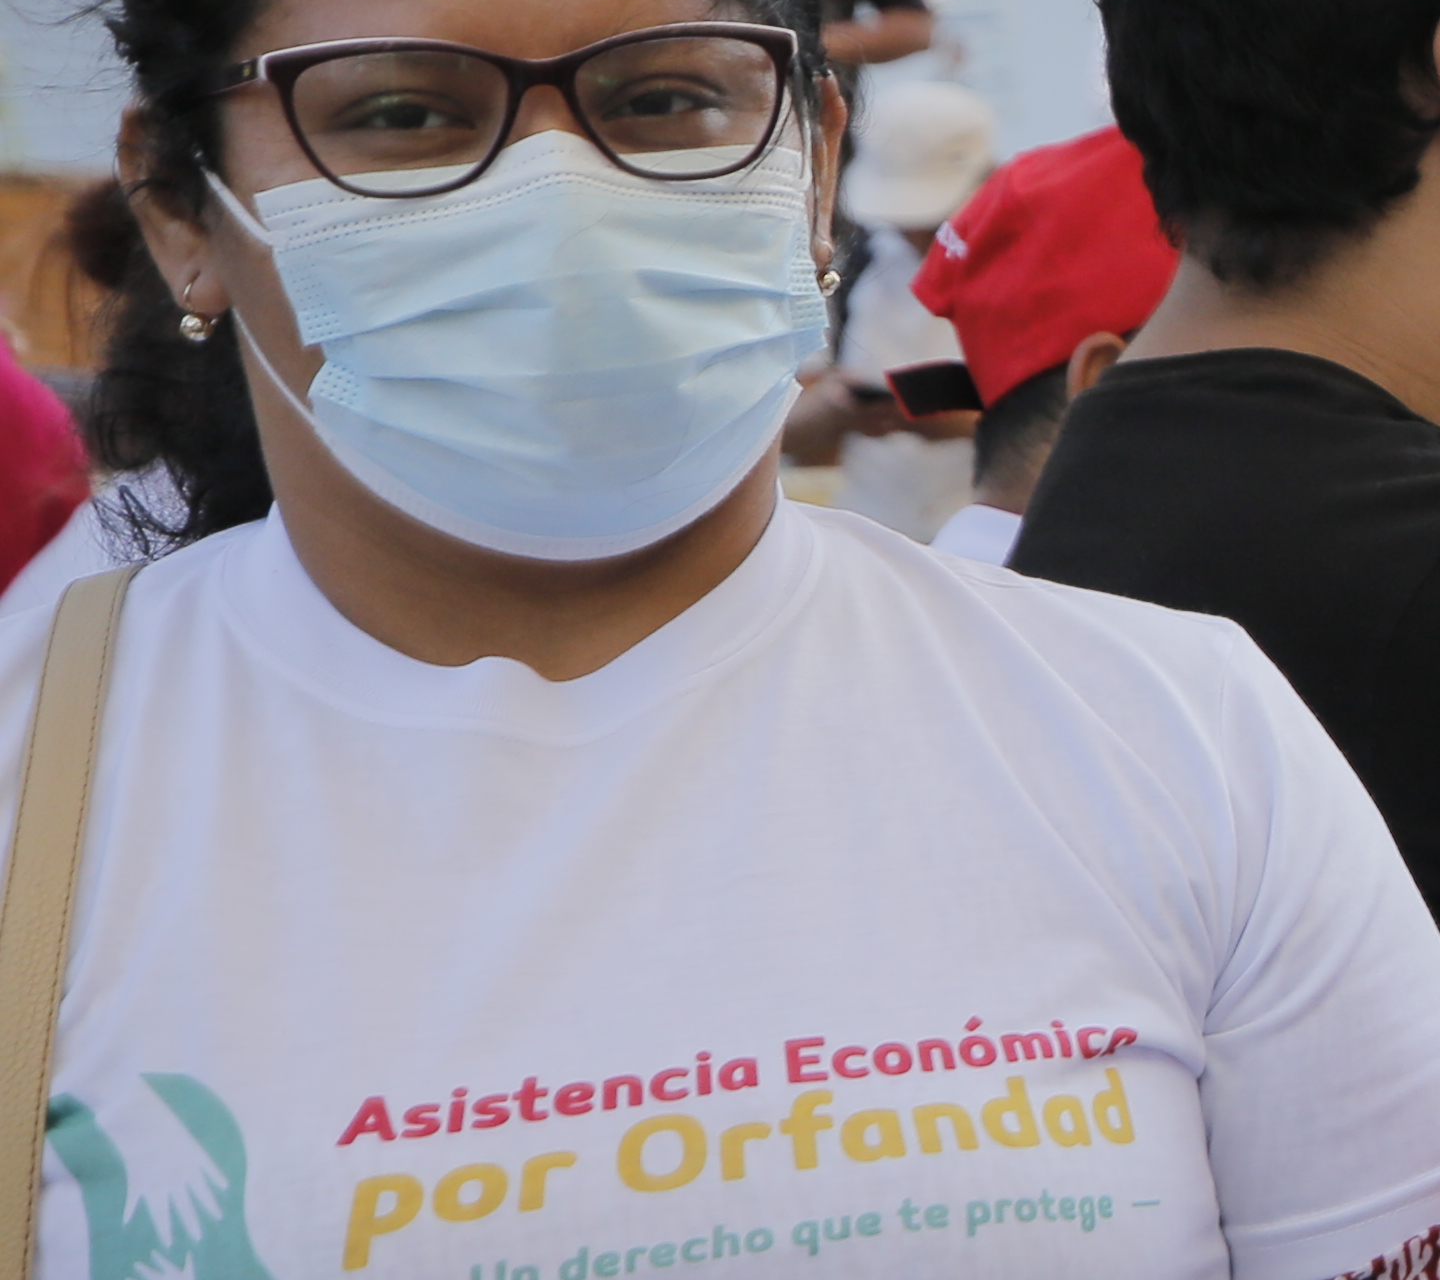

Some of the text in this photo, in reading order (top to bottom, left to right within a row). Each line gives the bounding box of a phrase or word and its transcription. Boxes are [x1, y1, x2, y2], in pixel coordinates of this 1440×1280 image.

[336, 1050, 759, 1147] Asistencia
[342, 1067, 1136, 1272] por Orfandad
[791, 1210, 883, 1257] que
[897, 1197, 950, 1232] te
[965, 1188, 1114, 1238] protege
